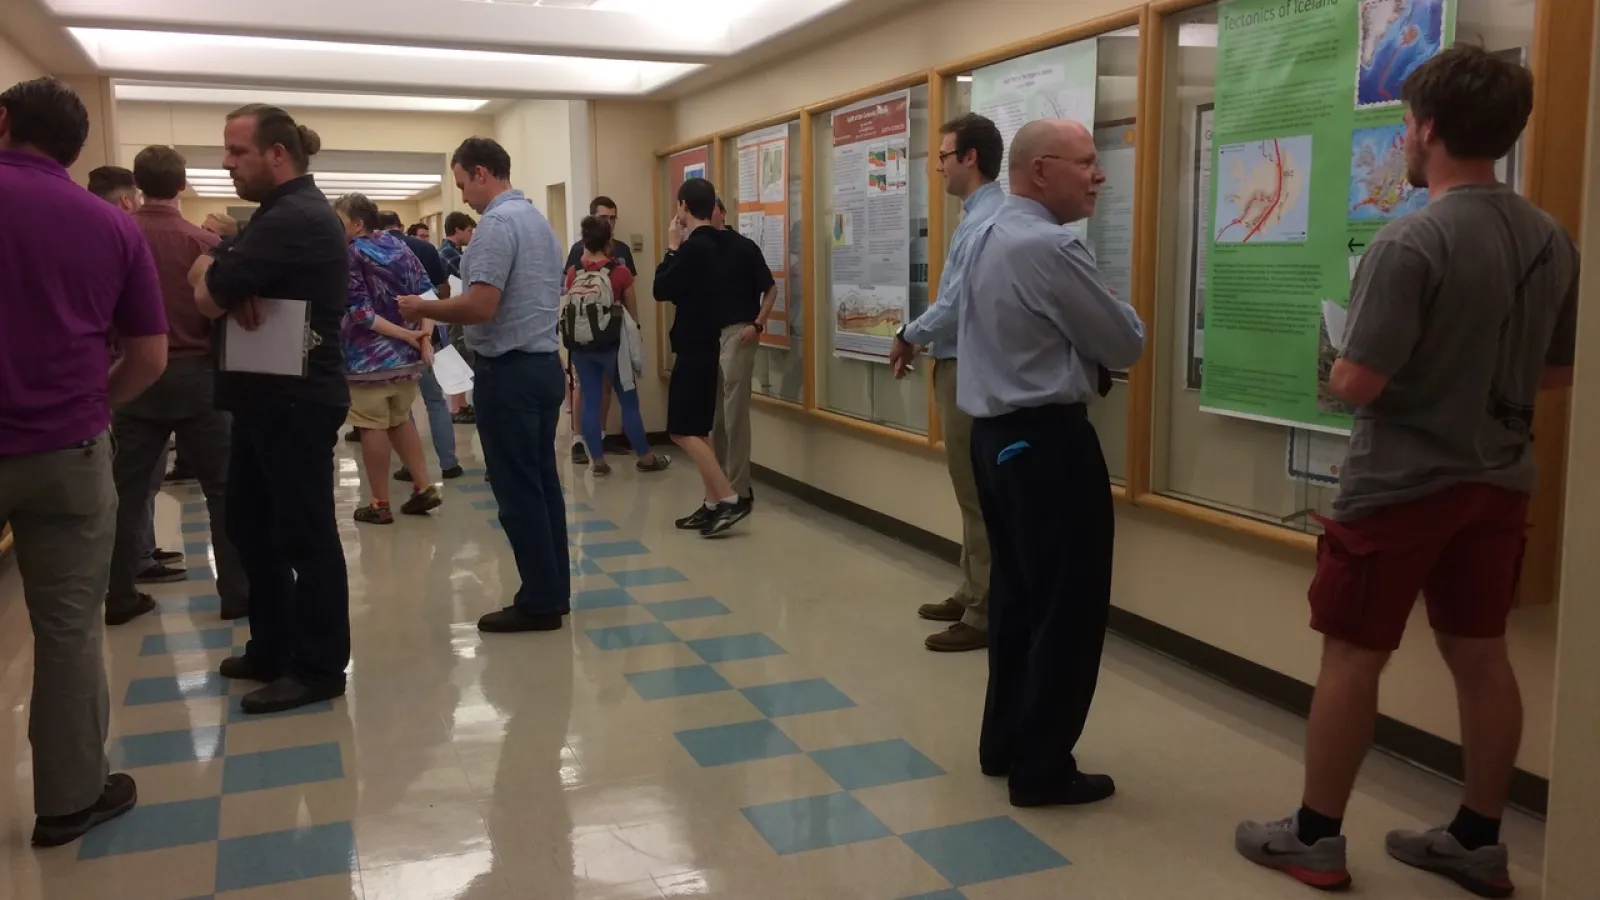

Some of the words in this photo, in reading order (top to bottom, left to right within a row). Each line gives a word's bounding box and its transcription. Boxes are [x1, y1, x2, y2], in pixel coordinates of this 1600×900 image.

[1224, 8, 1276, 31] Tectonics
[1278, 0, 1291, 18] of
[1294, 0, 1339, 14] Icelan
